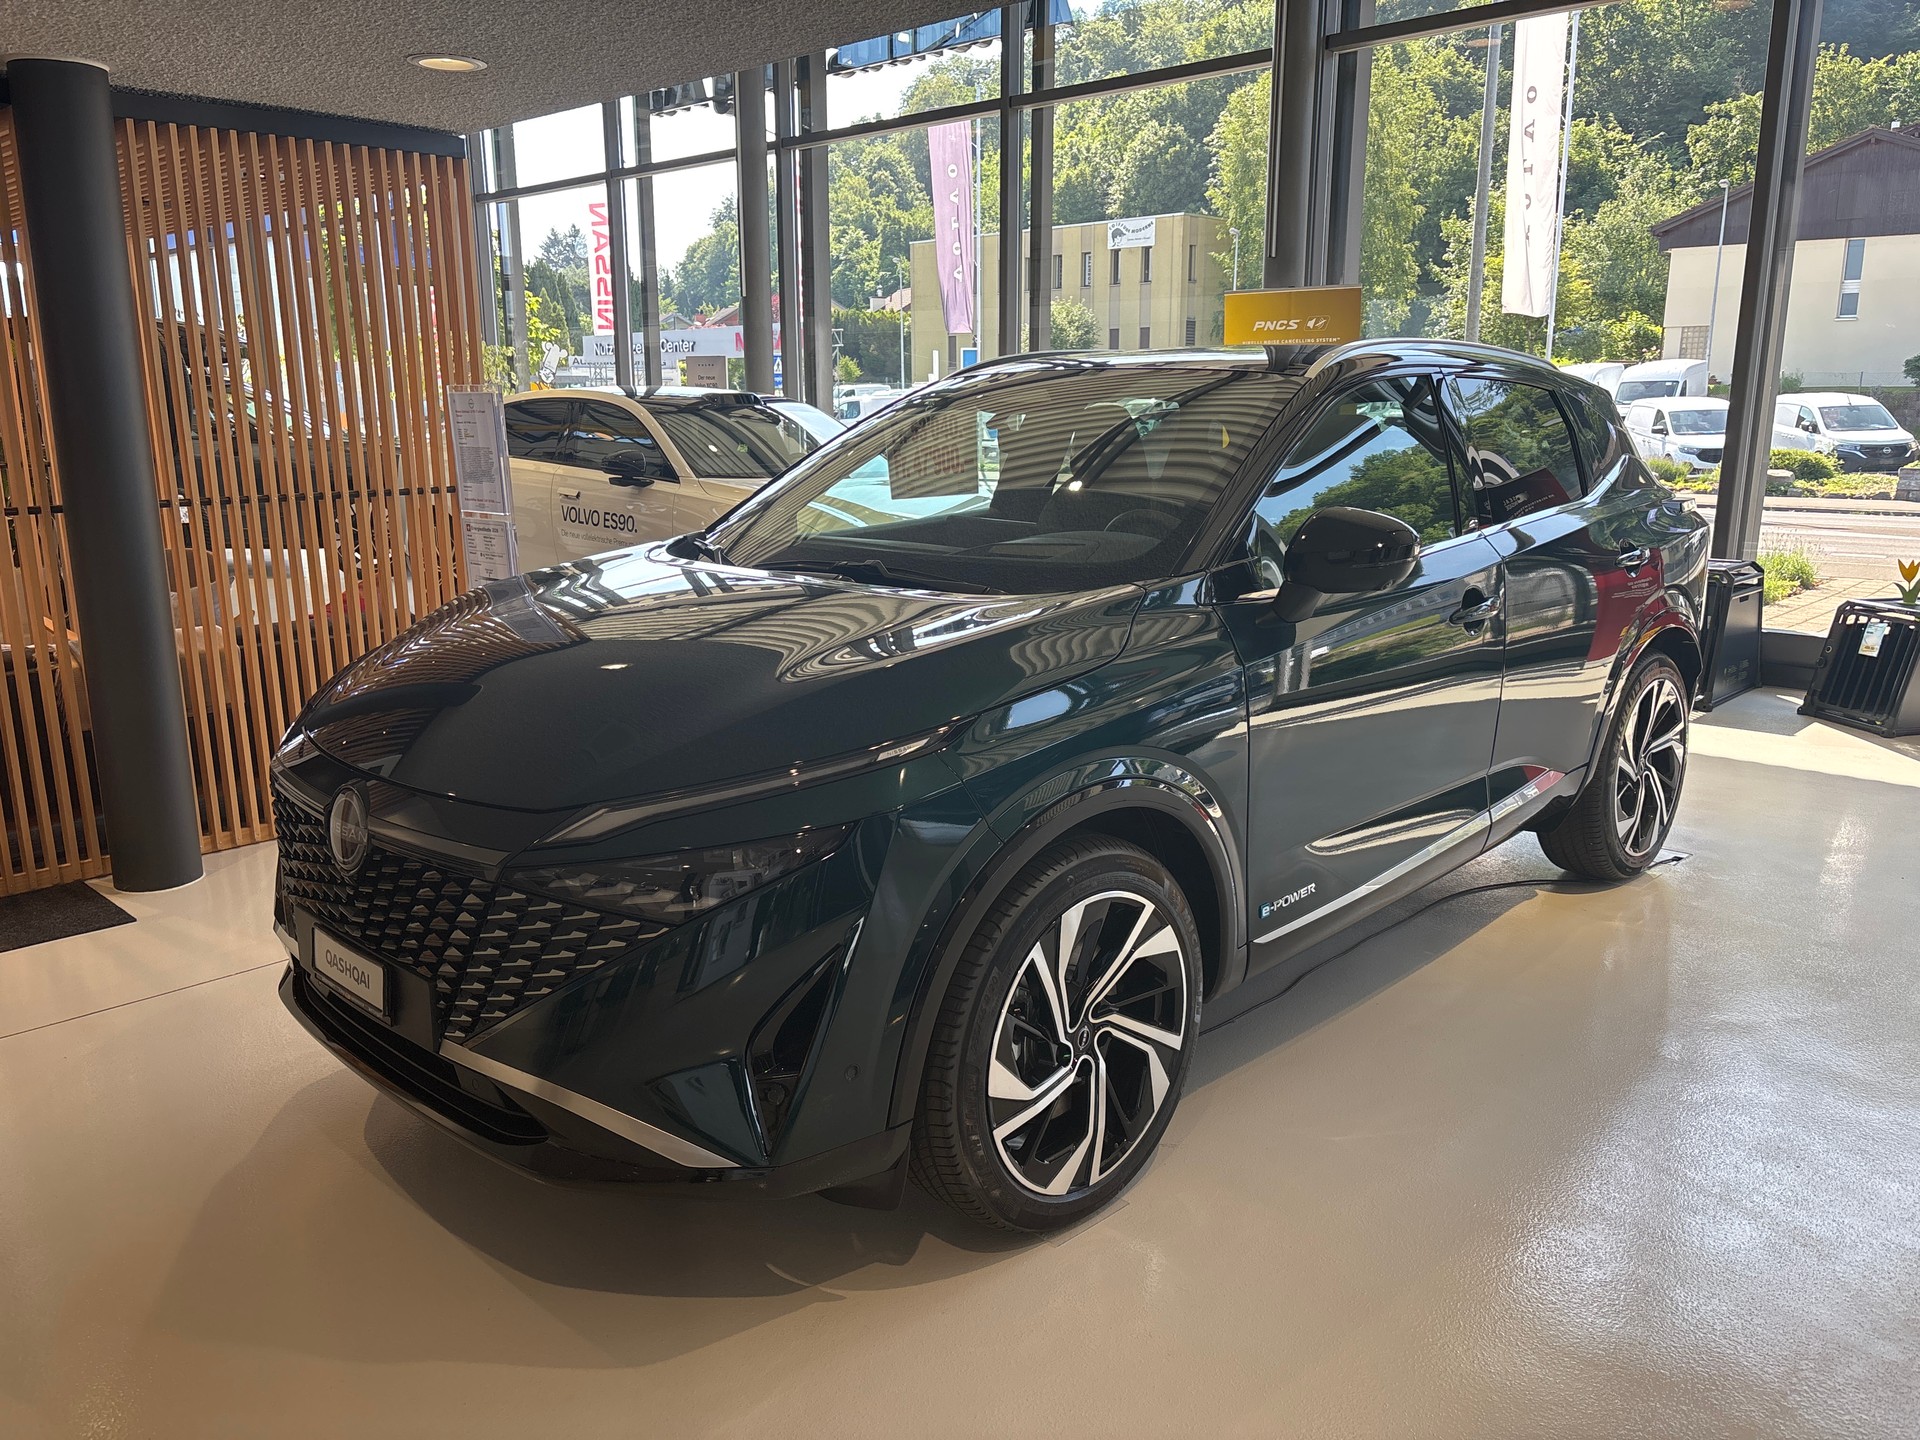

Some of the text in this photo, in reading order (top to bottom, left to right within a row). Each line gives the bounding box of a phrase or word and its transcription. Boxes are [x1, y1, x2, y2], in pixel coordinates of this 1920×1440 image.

[1252, 319, 1301, 332] PNCS
[561, 504, 638, 534] VOLVO ES90.
[561, 528, 569, 538] Die
[1261, 882, 1317, 917] e-POWER
[325, 948, 371, 990] QASHQAI
